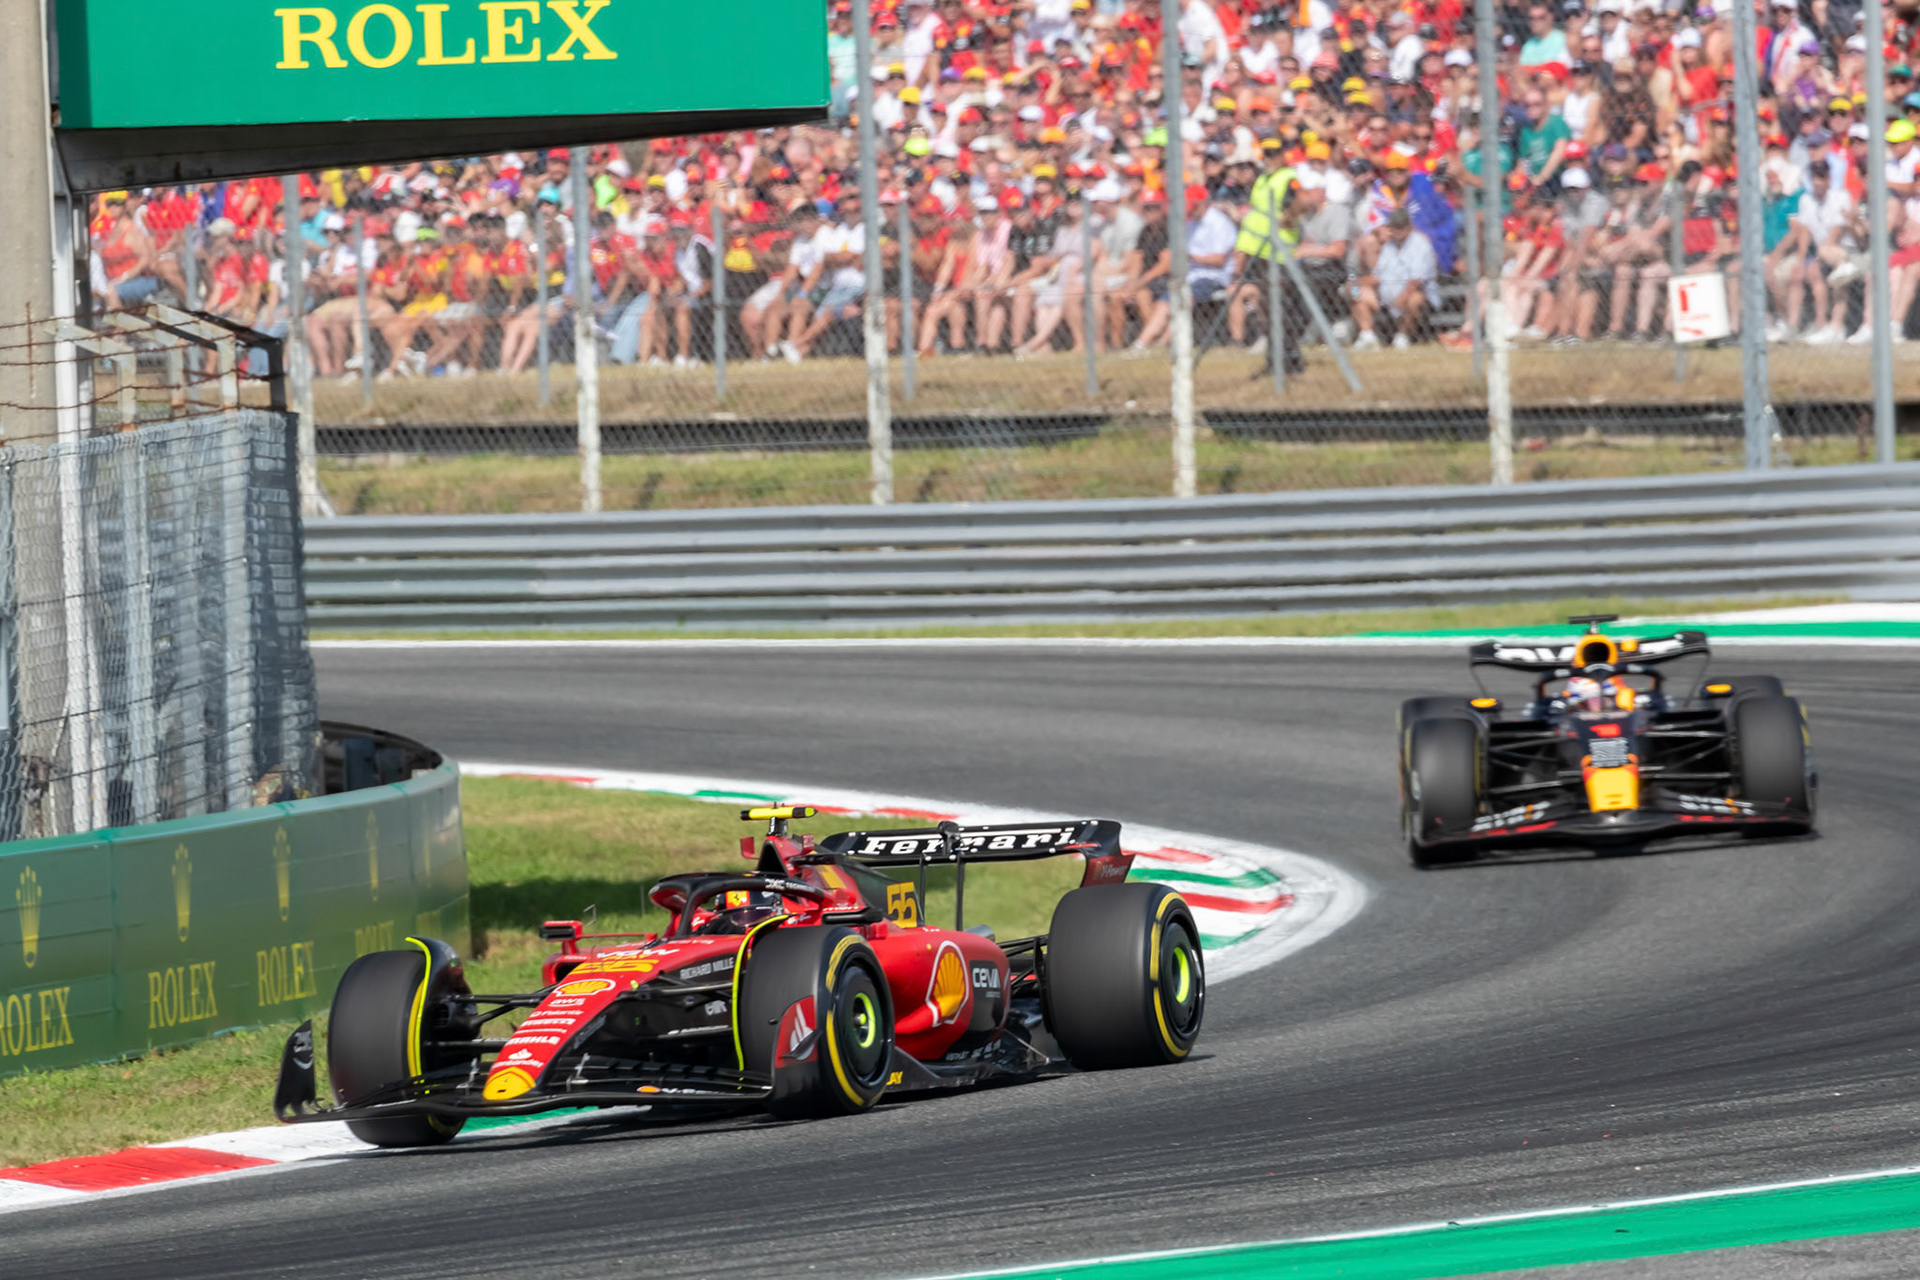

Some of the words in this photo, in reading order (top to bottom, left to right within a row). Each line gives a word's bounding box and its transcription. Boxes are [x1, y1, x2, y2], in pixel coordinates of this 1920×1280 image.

[274, 0, 618, 69] ROLEX
[887, 881, 918, 929] 55
[148, 961, 218, 1029] ROLEX
[257, 940, 318, 1007] ROLEX
[569, 959, 660, 975] 55
[679, 963, 712, 980] RICHARD
[712, 956, 735, 972] MILLE
